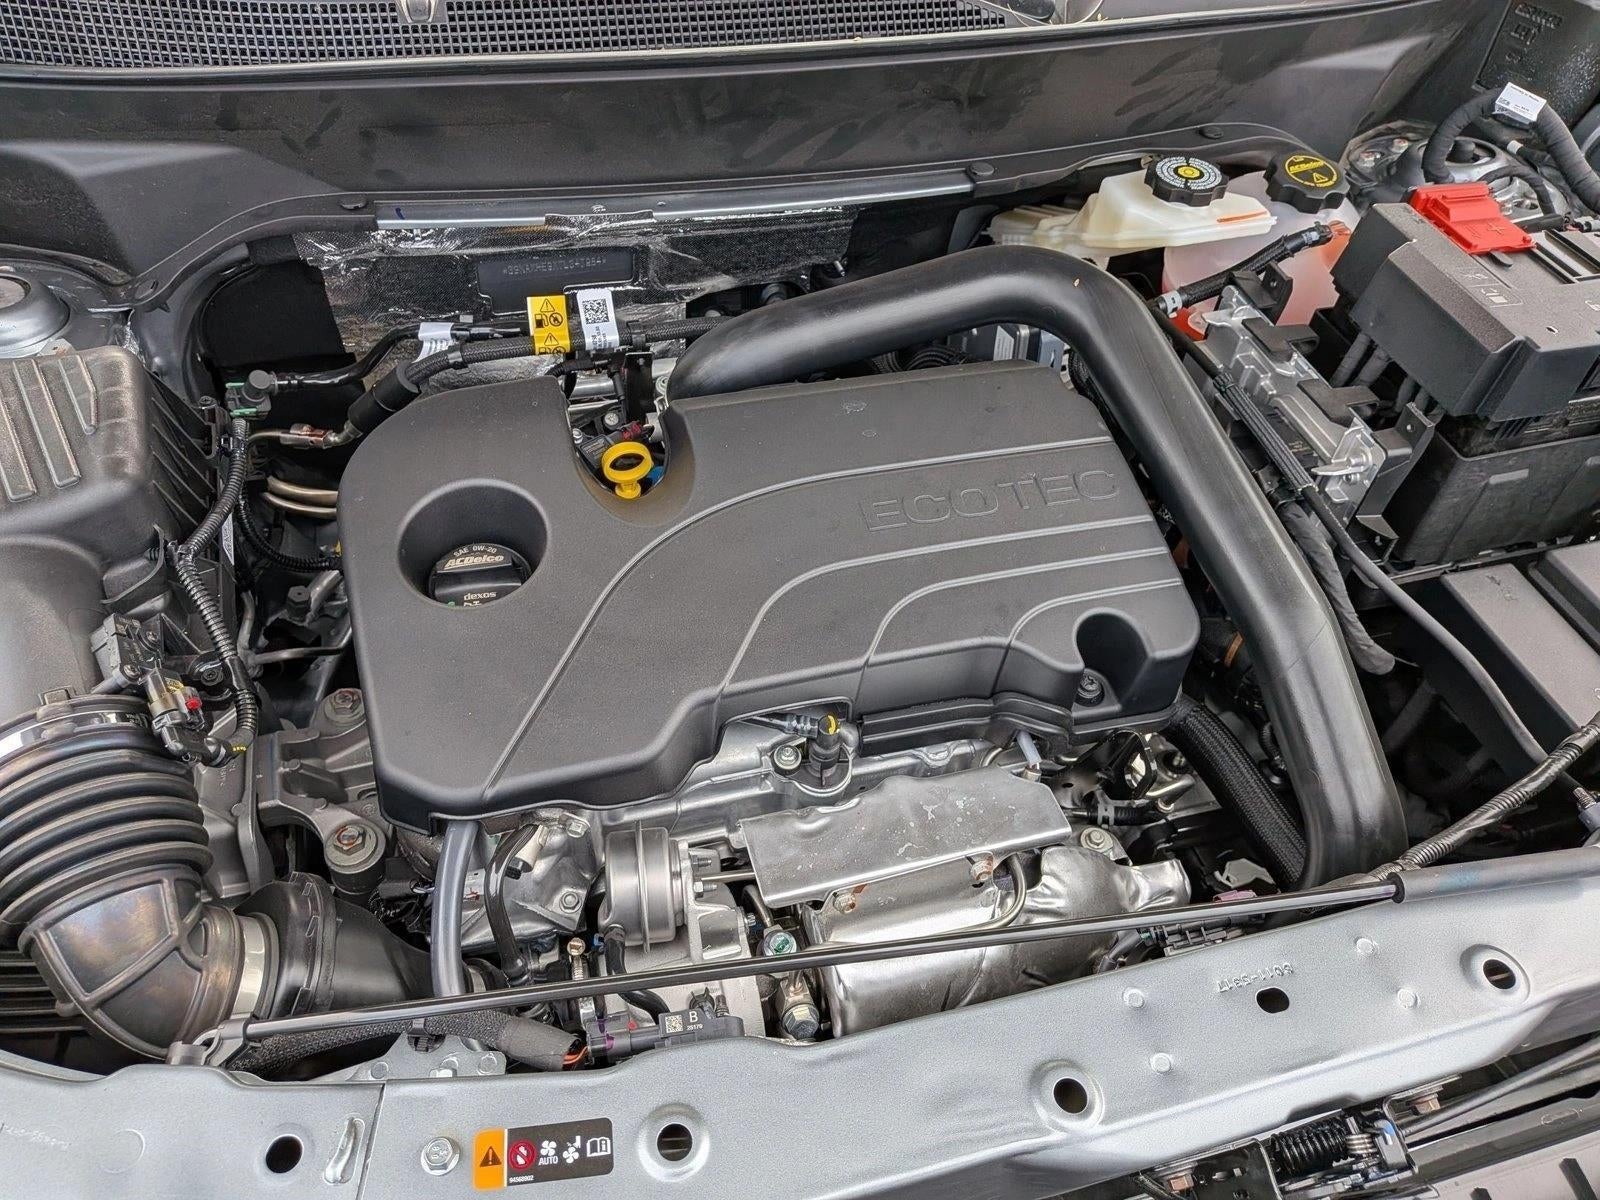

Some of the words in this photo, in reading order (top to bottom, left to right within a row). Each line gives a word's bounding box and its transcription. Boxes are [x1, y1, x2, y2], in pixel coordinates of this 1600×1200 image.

[858, 470, 1120, 531] ECOTEC
[453, 547, 469, 557] SAE
[472, 545, 497, 554] 0W-20
[444, 555, 504, 569] ACDelco
[463, 592, 497, 601] dexos
[689, 1010, 699, 1023] B
[538, 1155, 559, 1166] AUTO
